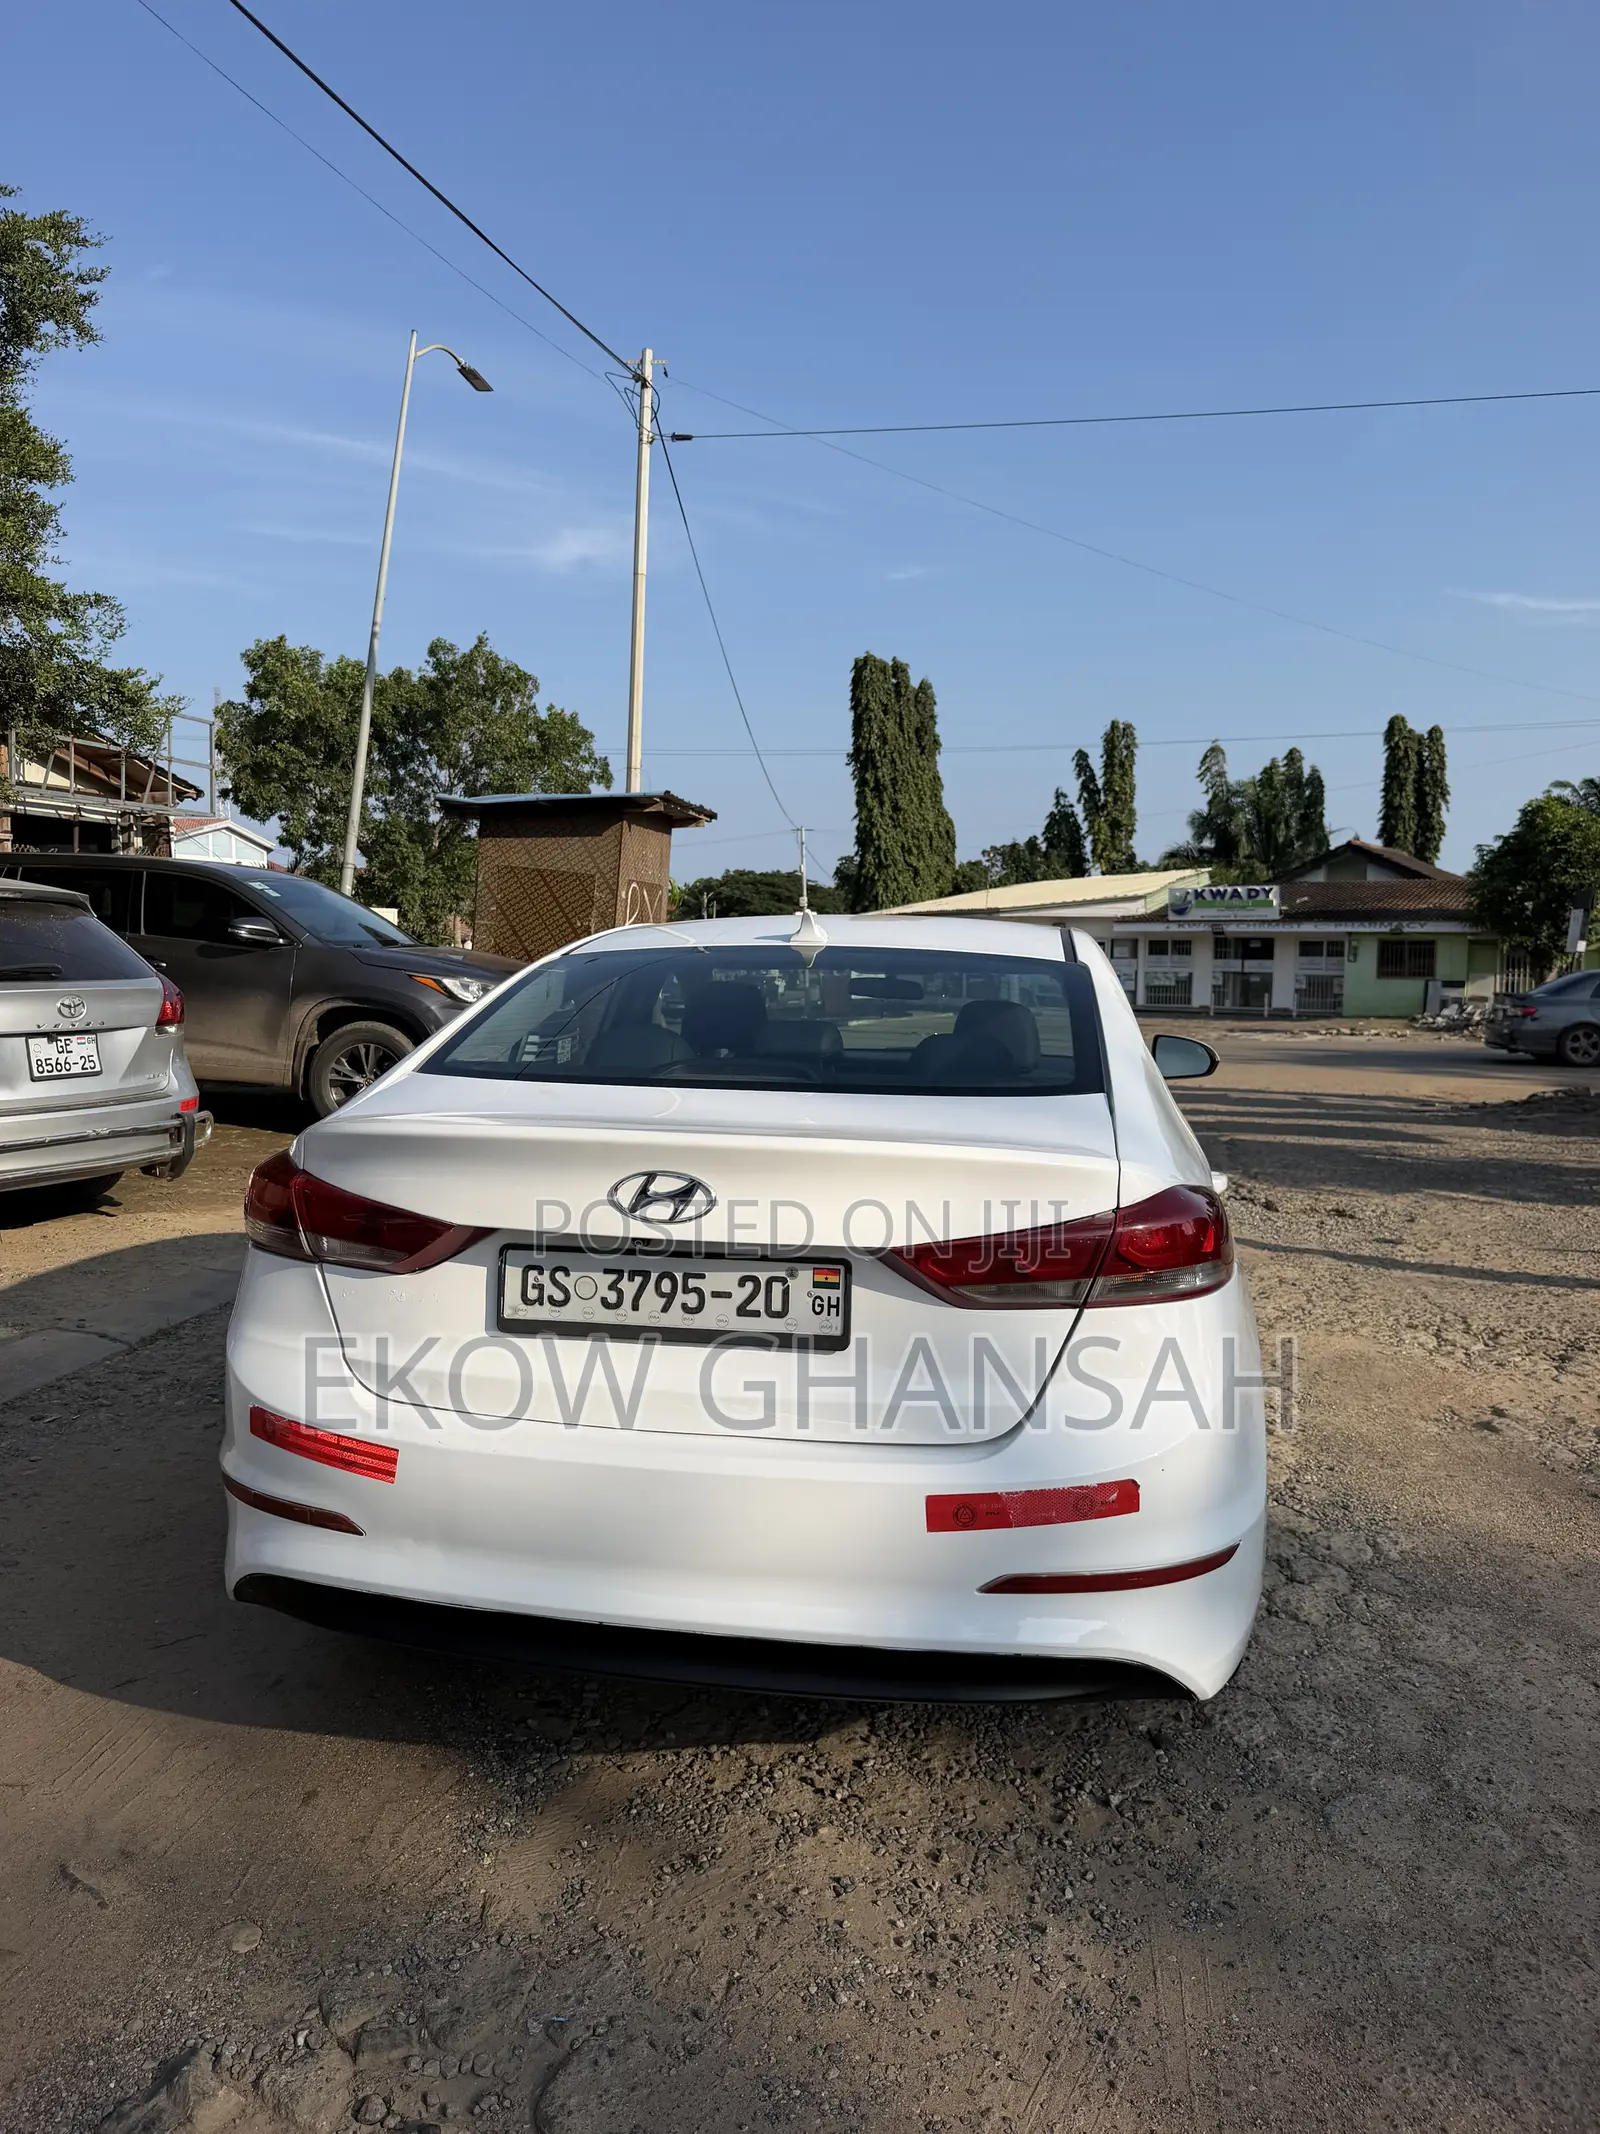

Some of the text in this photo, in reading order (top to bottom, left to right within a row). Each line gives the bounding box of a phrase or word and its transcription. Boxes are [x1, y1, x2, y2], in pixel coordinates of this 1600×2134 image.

[1194, 887, 1274, 900] KWADY
[55, 1038, 73, 1054] GE
[87, 1036, 96, 1045] GH
[35, 1055, 97, 1075] 8566-25
[520, 1264, 790, 1319] GS 3795-20
[811, 1295, 840, 1317] GH
